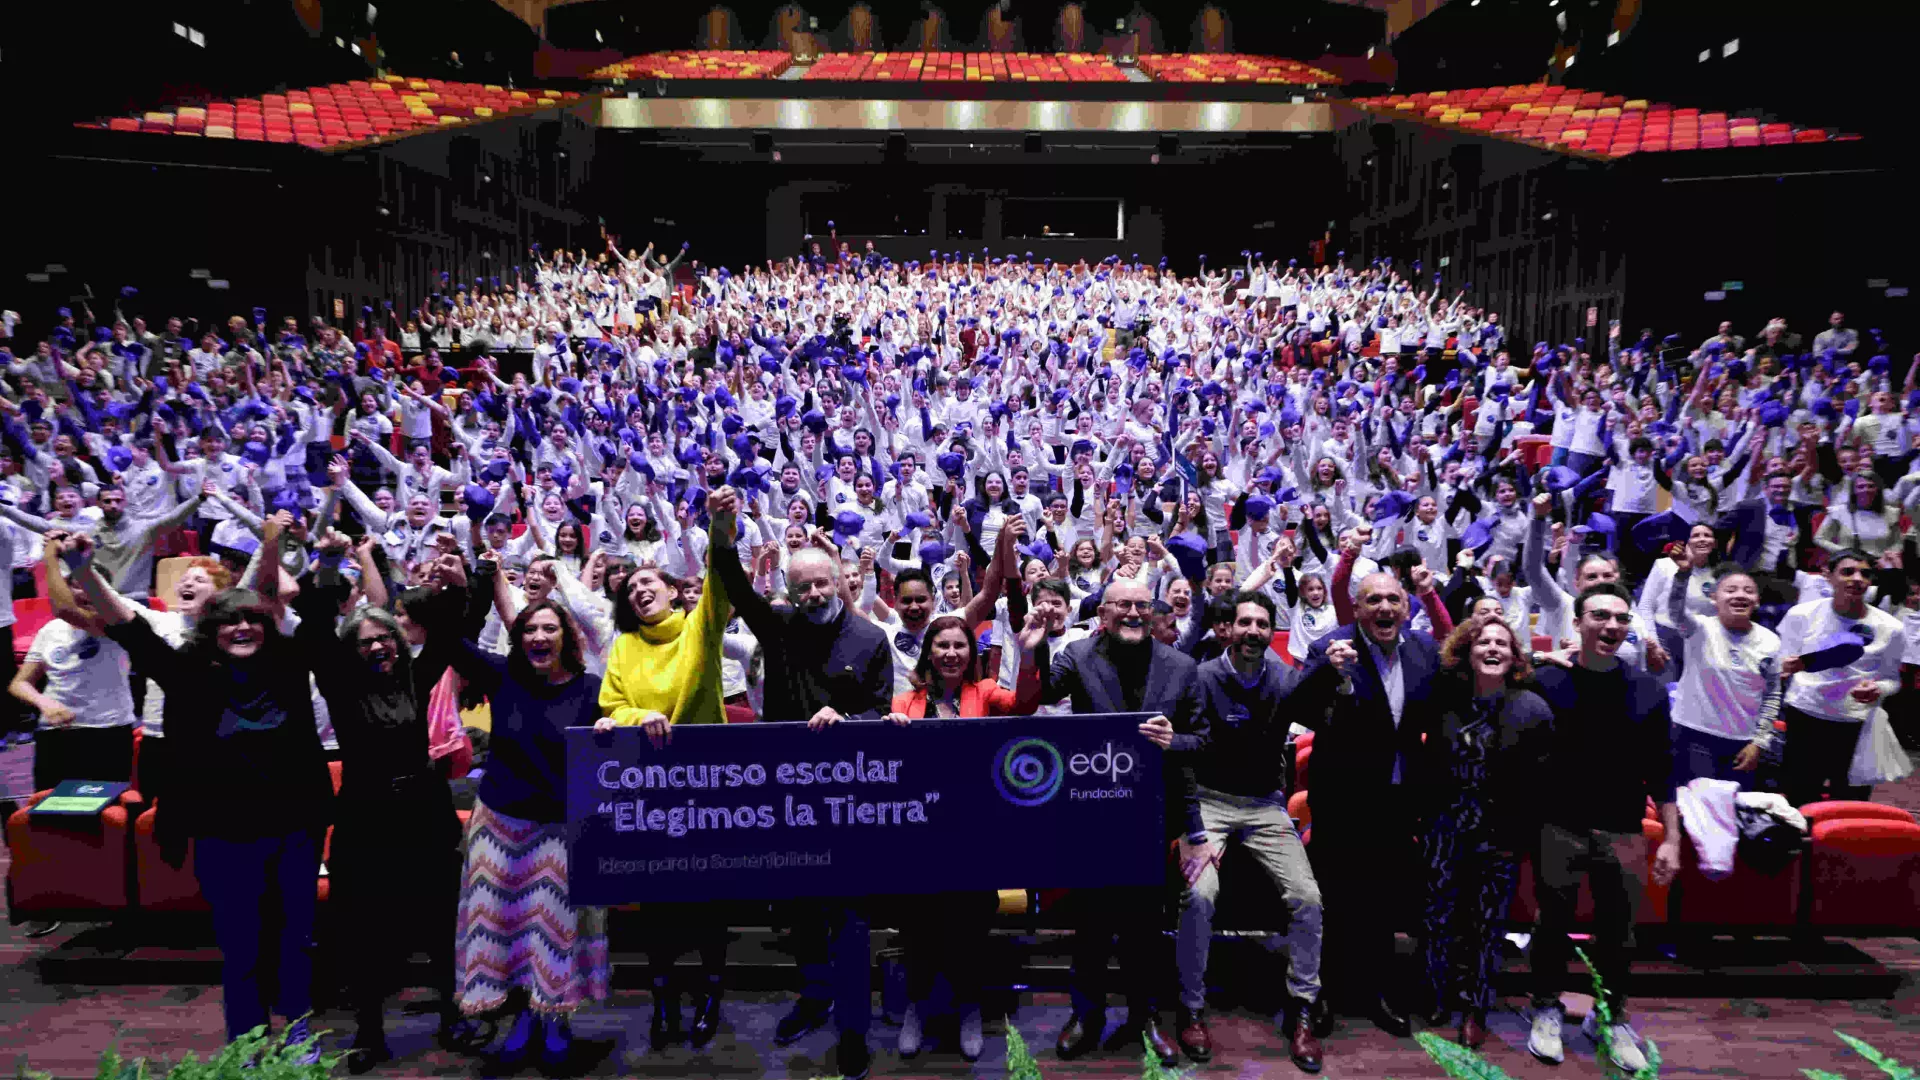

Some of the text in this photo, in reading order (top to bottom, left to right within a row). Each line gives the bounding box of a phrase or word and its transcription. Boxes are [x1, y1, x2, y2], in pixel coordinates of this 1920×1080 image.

[597, 751, 902, 789] Concurso escolar
[1069, 742, 1133, 782] edp
[1070, 787, 1133, 799] Fundación
[598, 792, 940, 837] “Elegimos la Tierra”
[598, 849, 831, 874] Ideas para la Sostenibilidad
